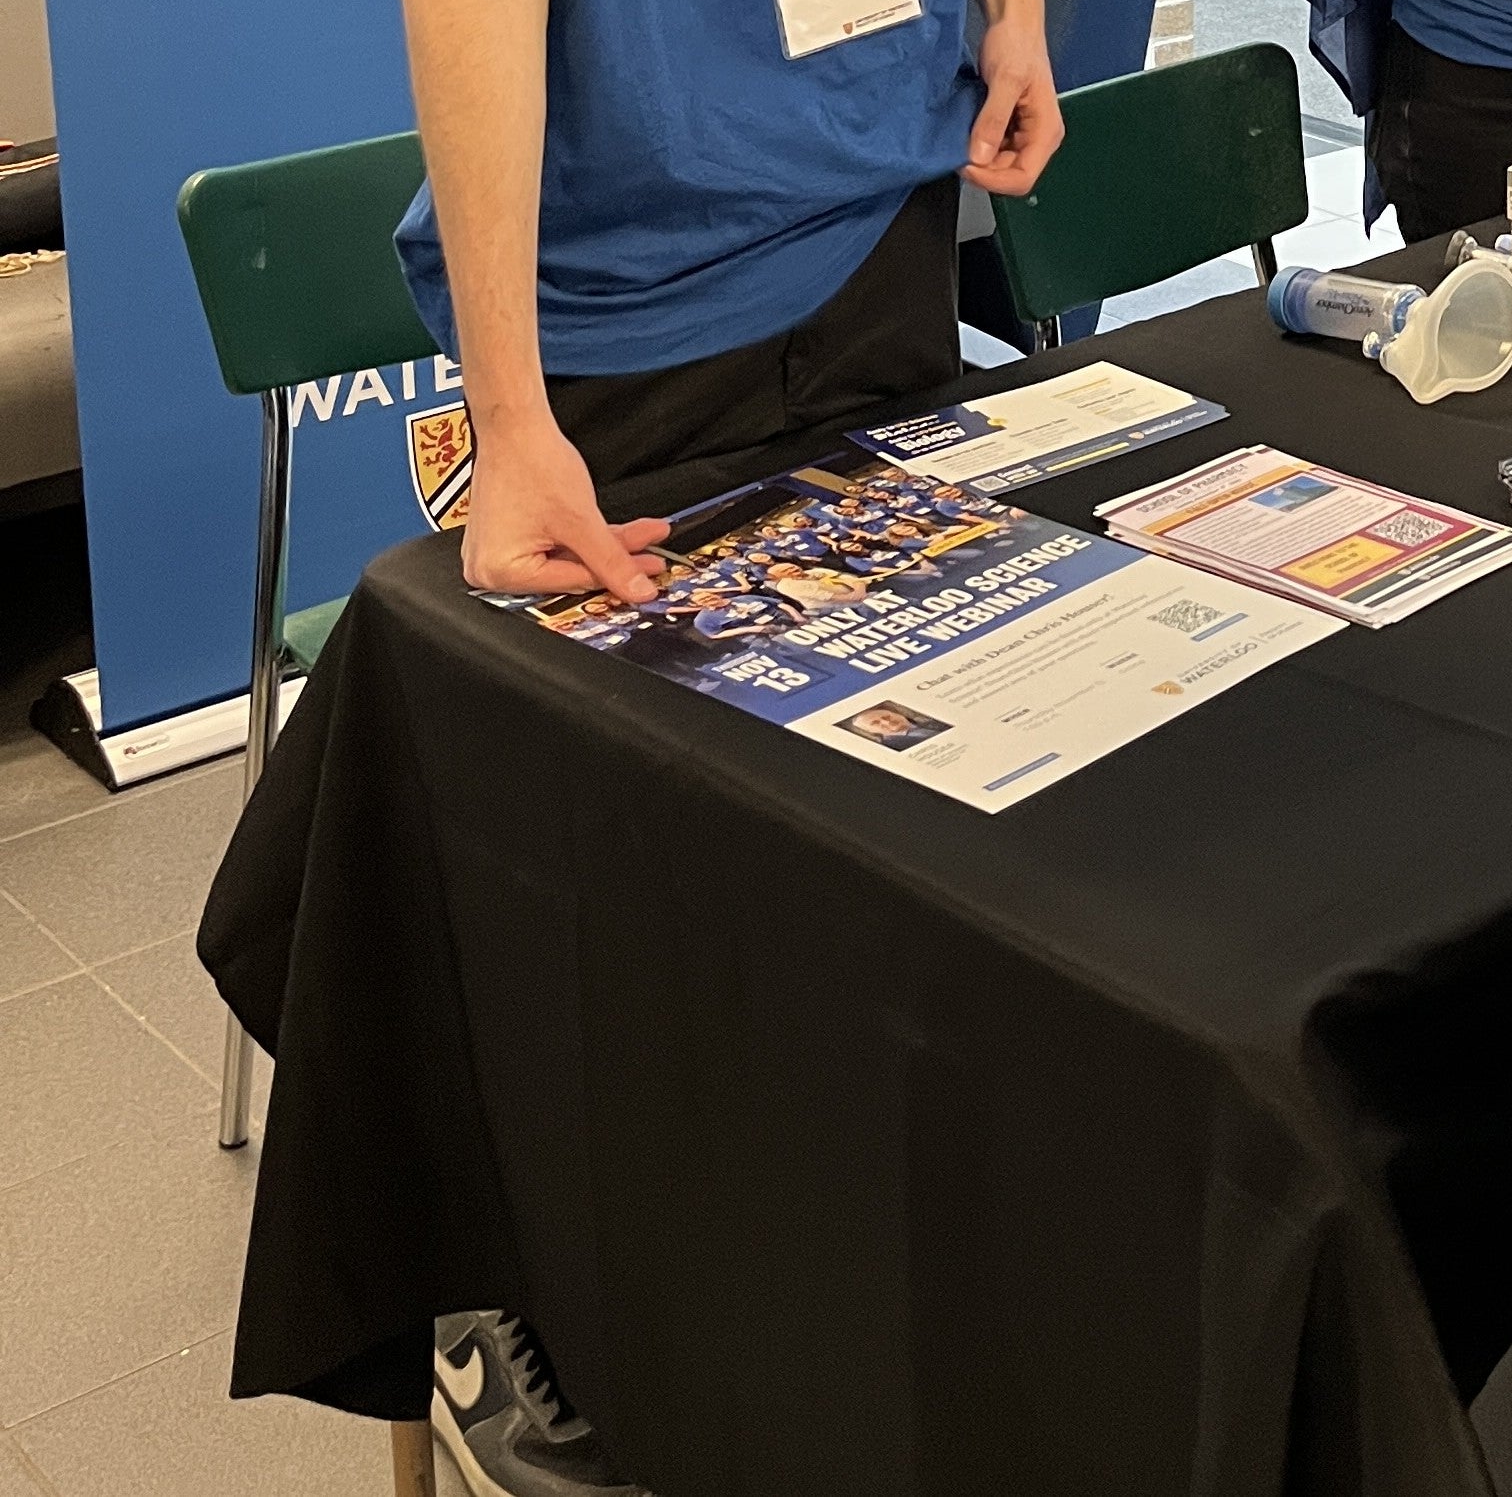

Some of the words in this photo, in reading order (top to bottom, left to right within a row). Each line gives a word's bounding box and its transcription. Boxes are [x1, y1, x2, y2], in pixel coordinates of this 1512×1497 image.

[785, 608, 867, 647] ONLY
[863, 589, 911, 615] AT
[813, 589, 974, 660] WATERLOO
[966, 533, 1092, 595] SCIENCE
[848, 631, 932, 674] LIVE
[924, 576, 1058, 643] WEBINAR
[722, 655, 779, 682] NOV
[753, 667, 810, 693] 13
[916, 672, 953, 693] Chat
[954, 654, 985, 678] with
[986, 639, 1024, 662] Dean
[1180, 642, 1258, 684] WATERLOO
